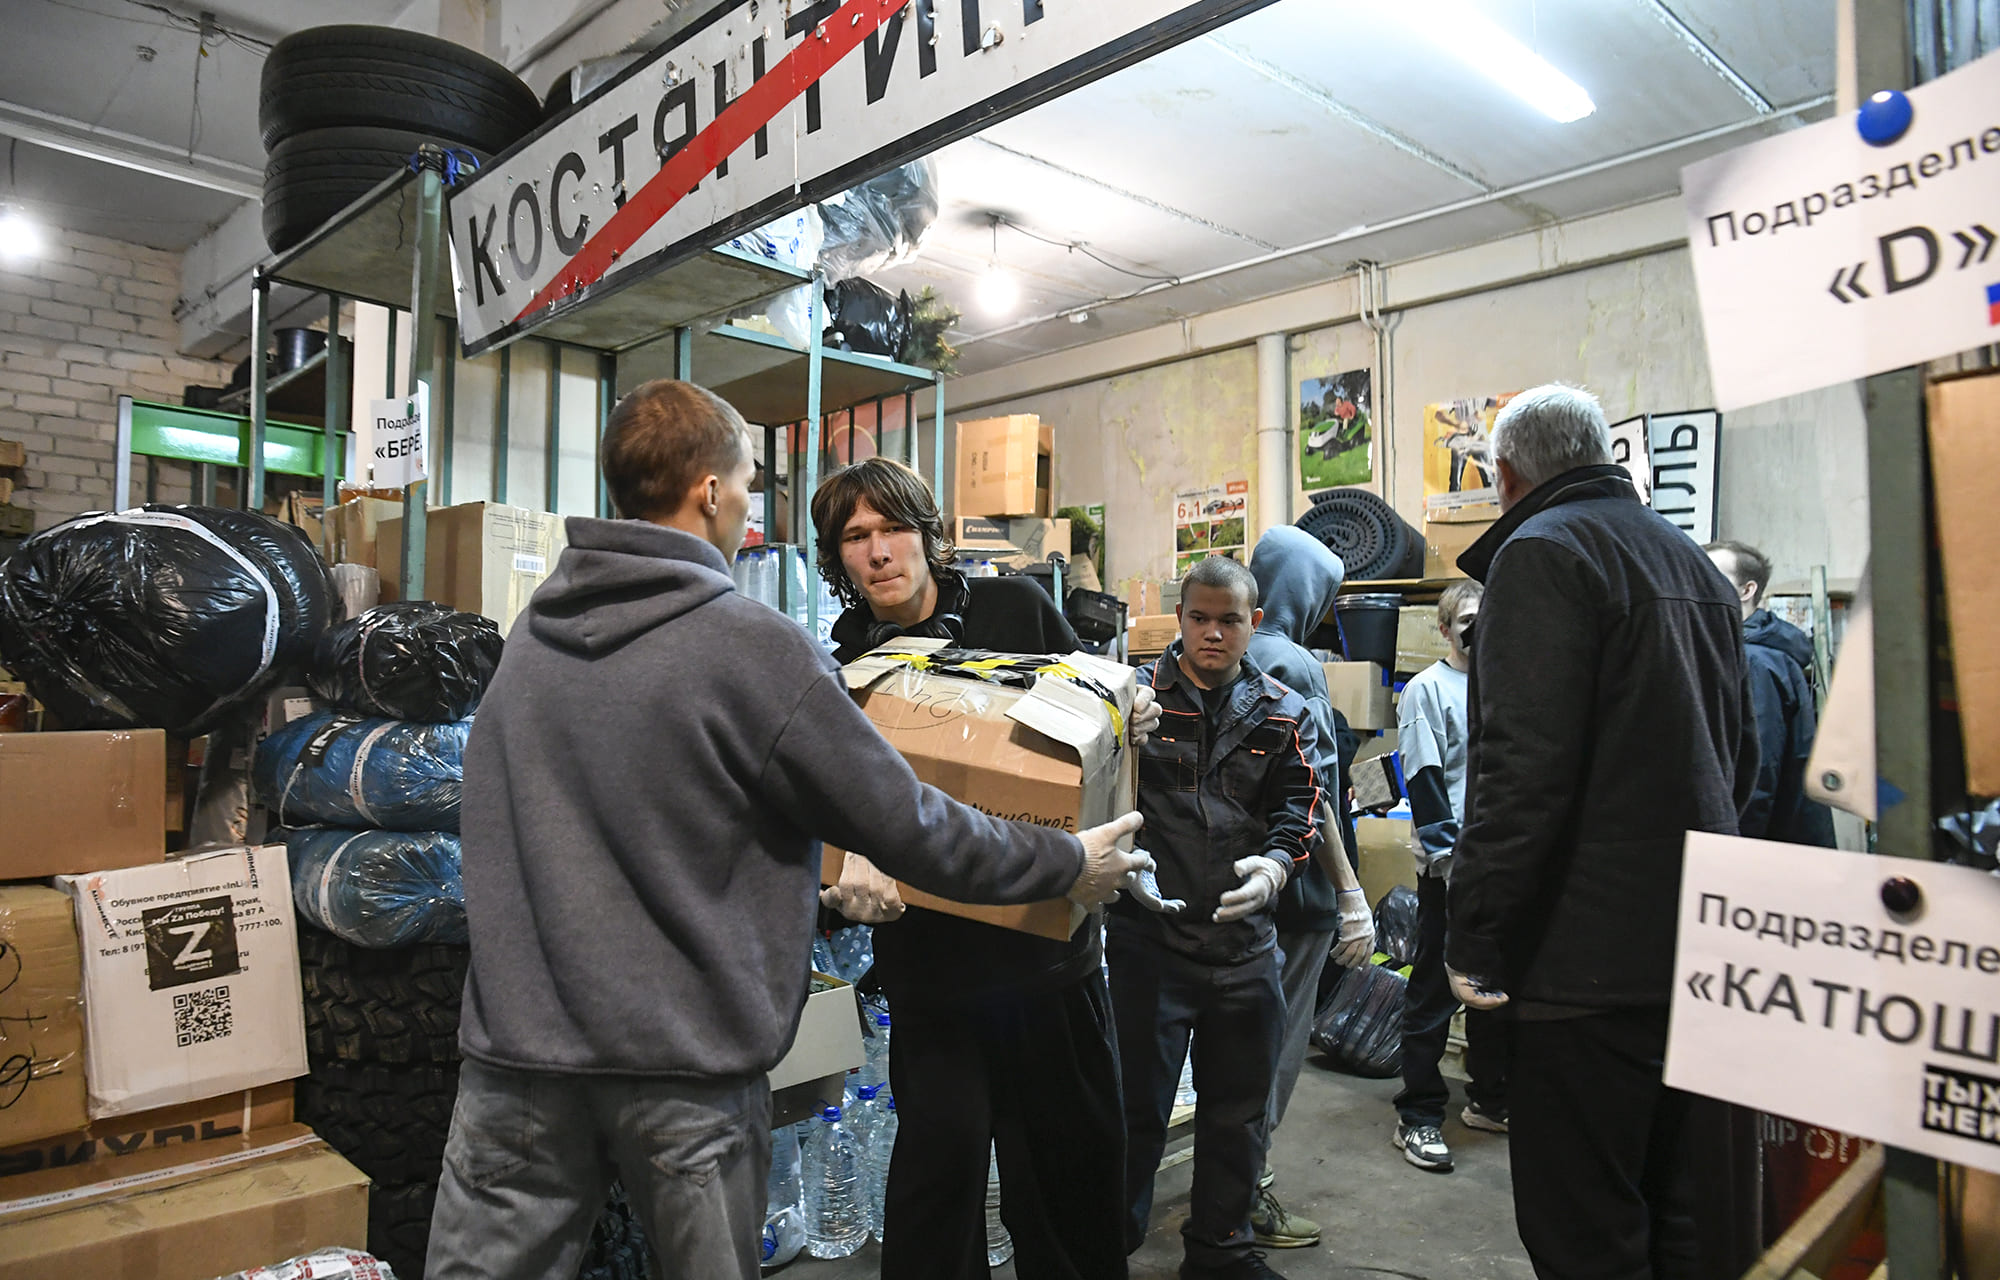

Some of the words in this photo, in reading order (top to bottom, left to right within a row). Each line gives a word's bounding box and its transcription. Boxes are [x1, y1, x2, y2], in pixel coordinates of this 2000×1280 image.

[1705, 125, 2000, 248] Подразделе
[1827, 223, 1998, 304] «D»
[375, 429, 422, 459] «БЕРЁ
[1177, 502, 1186, 519] 6
[1194, 500, 1200, 516] 1
[245, 847, 258, 889] ЫВМЕСТЕ
[111, 895, 155, 908] Обувное
[157, 885, 221, 901] предприятие
[115, 916, 143, 927] Росси
[186, 905, 225, 920] Победу!
[1698, 892, 2000, 975] Подразделе
[99, 947, 121, 957] Тел:
[130, 942, 146, 953] (91
[1687, 961, 2000, 1065] «КАТЮШ
